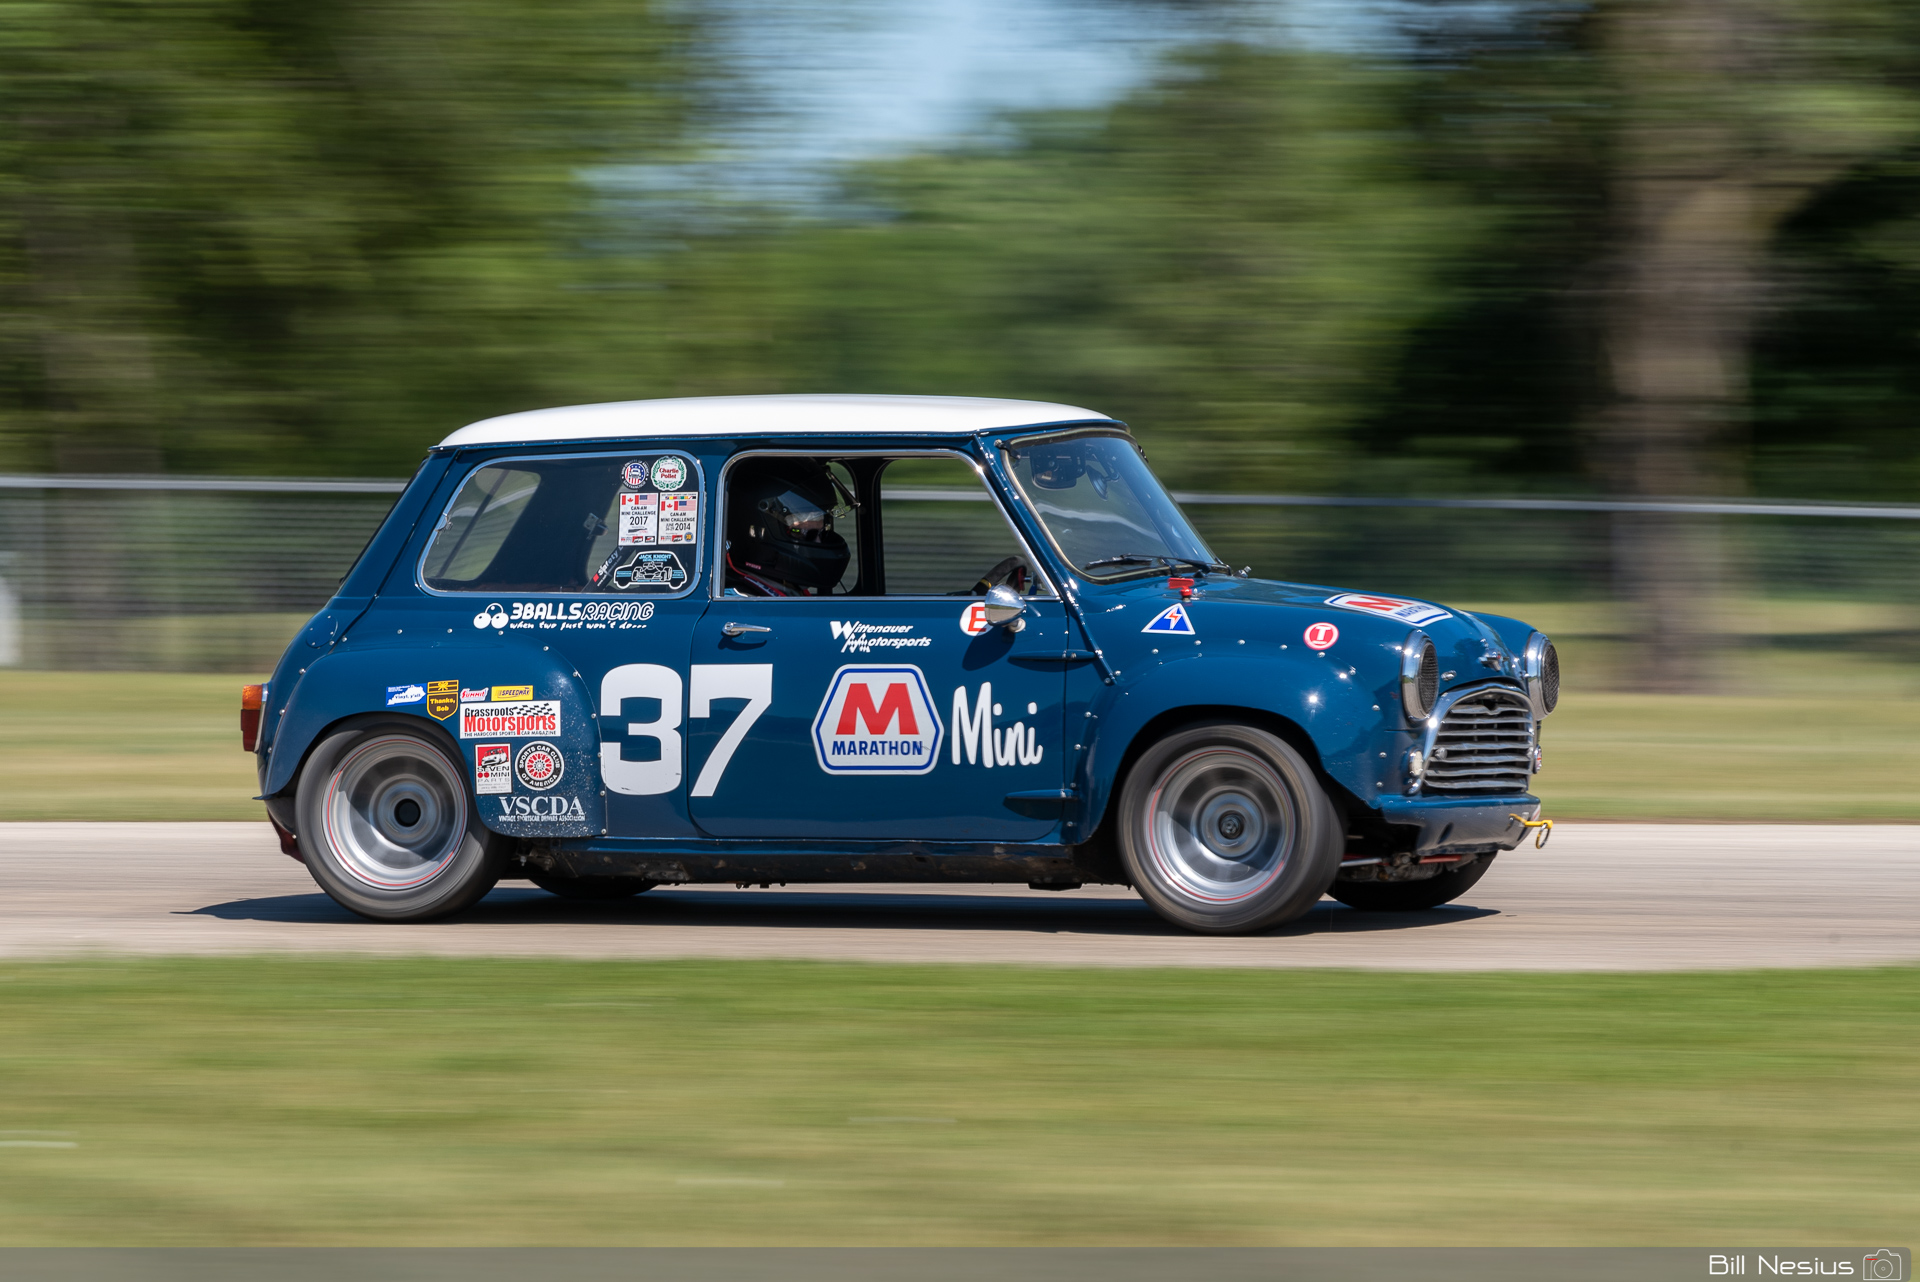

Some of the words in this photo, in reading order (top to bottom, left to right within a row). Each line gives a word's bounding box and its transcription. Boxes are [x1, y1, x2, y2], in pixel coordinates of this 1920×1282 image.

[629, 516, 648, 526] 2017
[674, 522, 691, 531] 2014
[509, 621, 535, 629] when
[538, 621, 558, 629] two
[560, 621, 584, 631] just
[586, 620, 617, 629] won't
[967, 606, 988, 632] E
[830, 620, 914, 640] Wittenauer
[840, 632, 932, 653] Motorsports
[430, 697, 456, 705] Thanks,
[835, 683, 920, 735] M
[464, 707, 514, 717] Grassroots
[464, 715, 556, 735] Motorsports
[600, 663, 773, 797] 37
[952, 681, 1044, 768] Mini
[519, 746, 536, 768] SPORTS
[550, 751, 560, 769] CLUB
[832, 740, 923, 756] MARATHON
[477, 765, 510, 773] SEVEN
[521, 773, 529, 781] OF
[529, 774, 558, 787] AMERICA
[499, 795, 586, 816] VSCDA
